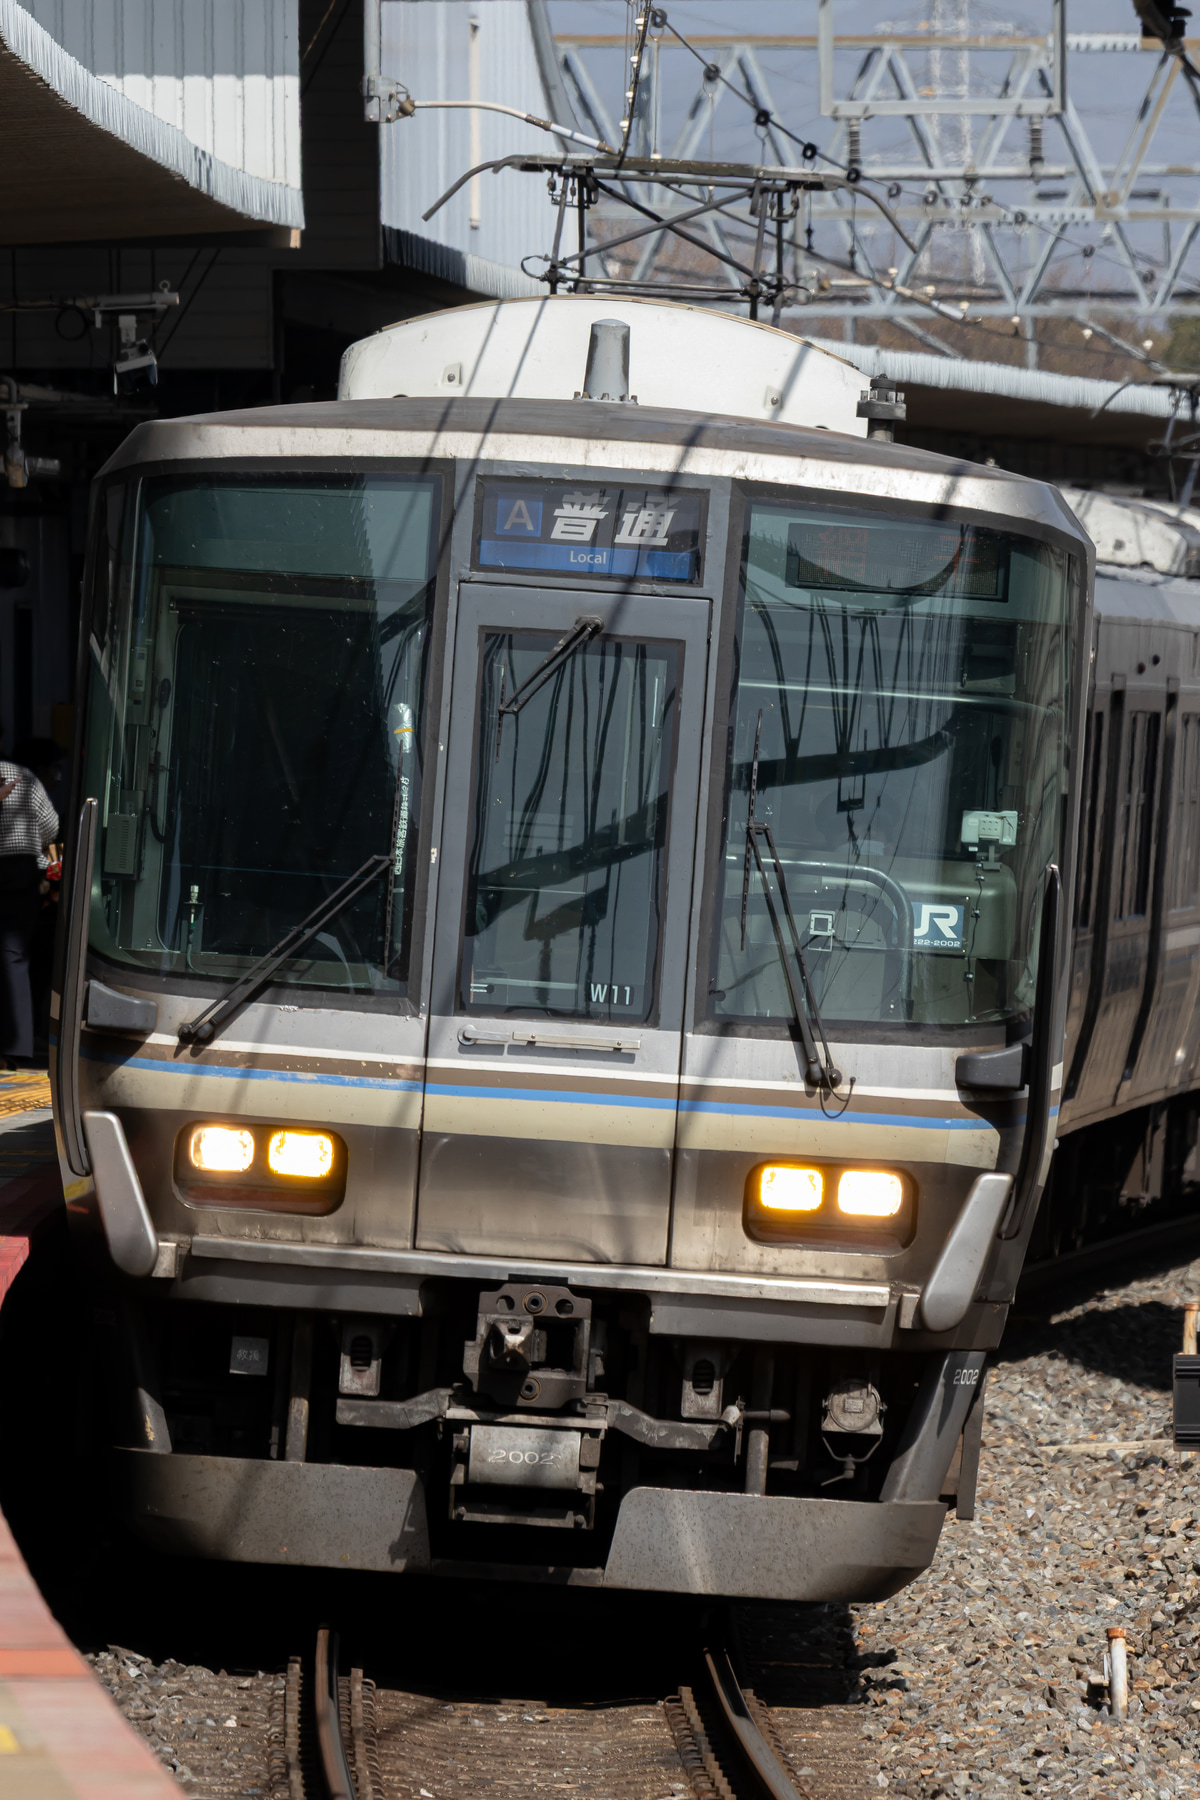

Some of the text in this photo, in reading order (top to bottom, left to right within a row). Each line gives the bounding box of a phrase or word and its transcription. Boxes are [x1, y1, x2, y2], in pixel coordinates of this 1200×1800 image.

[504, 499, 534, 531] A
[550, 490, 682, 546] 普通
[570, 550, 607, 565] Local
[913, 904, 958, 939] JR
[590, 983, 630, 1006] W11
[953, 1368, 979, 1385] 2002
[487, 1449, 554, 1466] 2002
